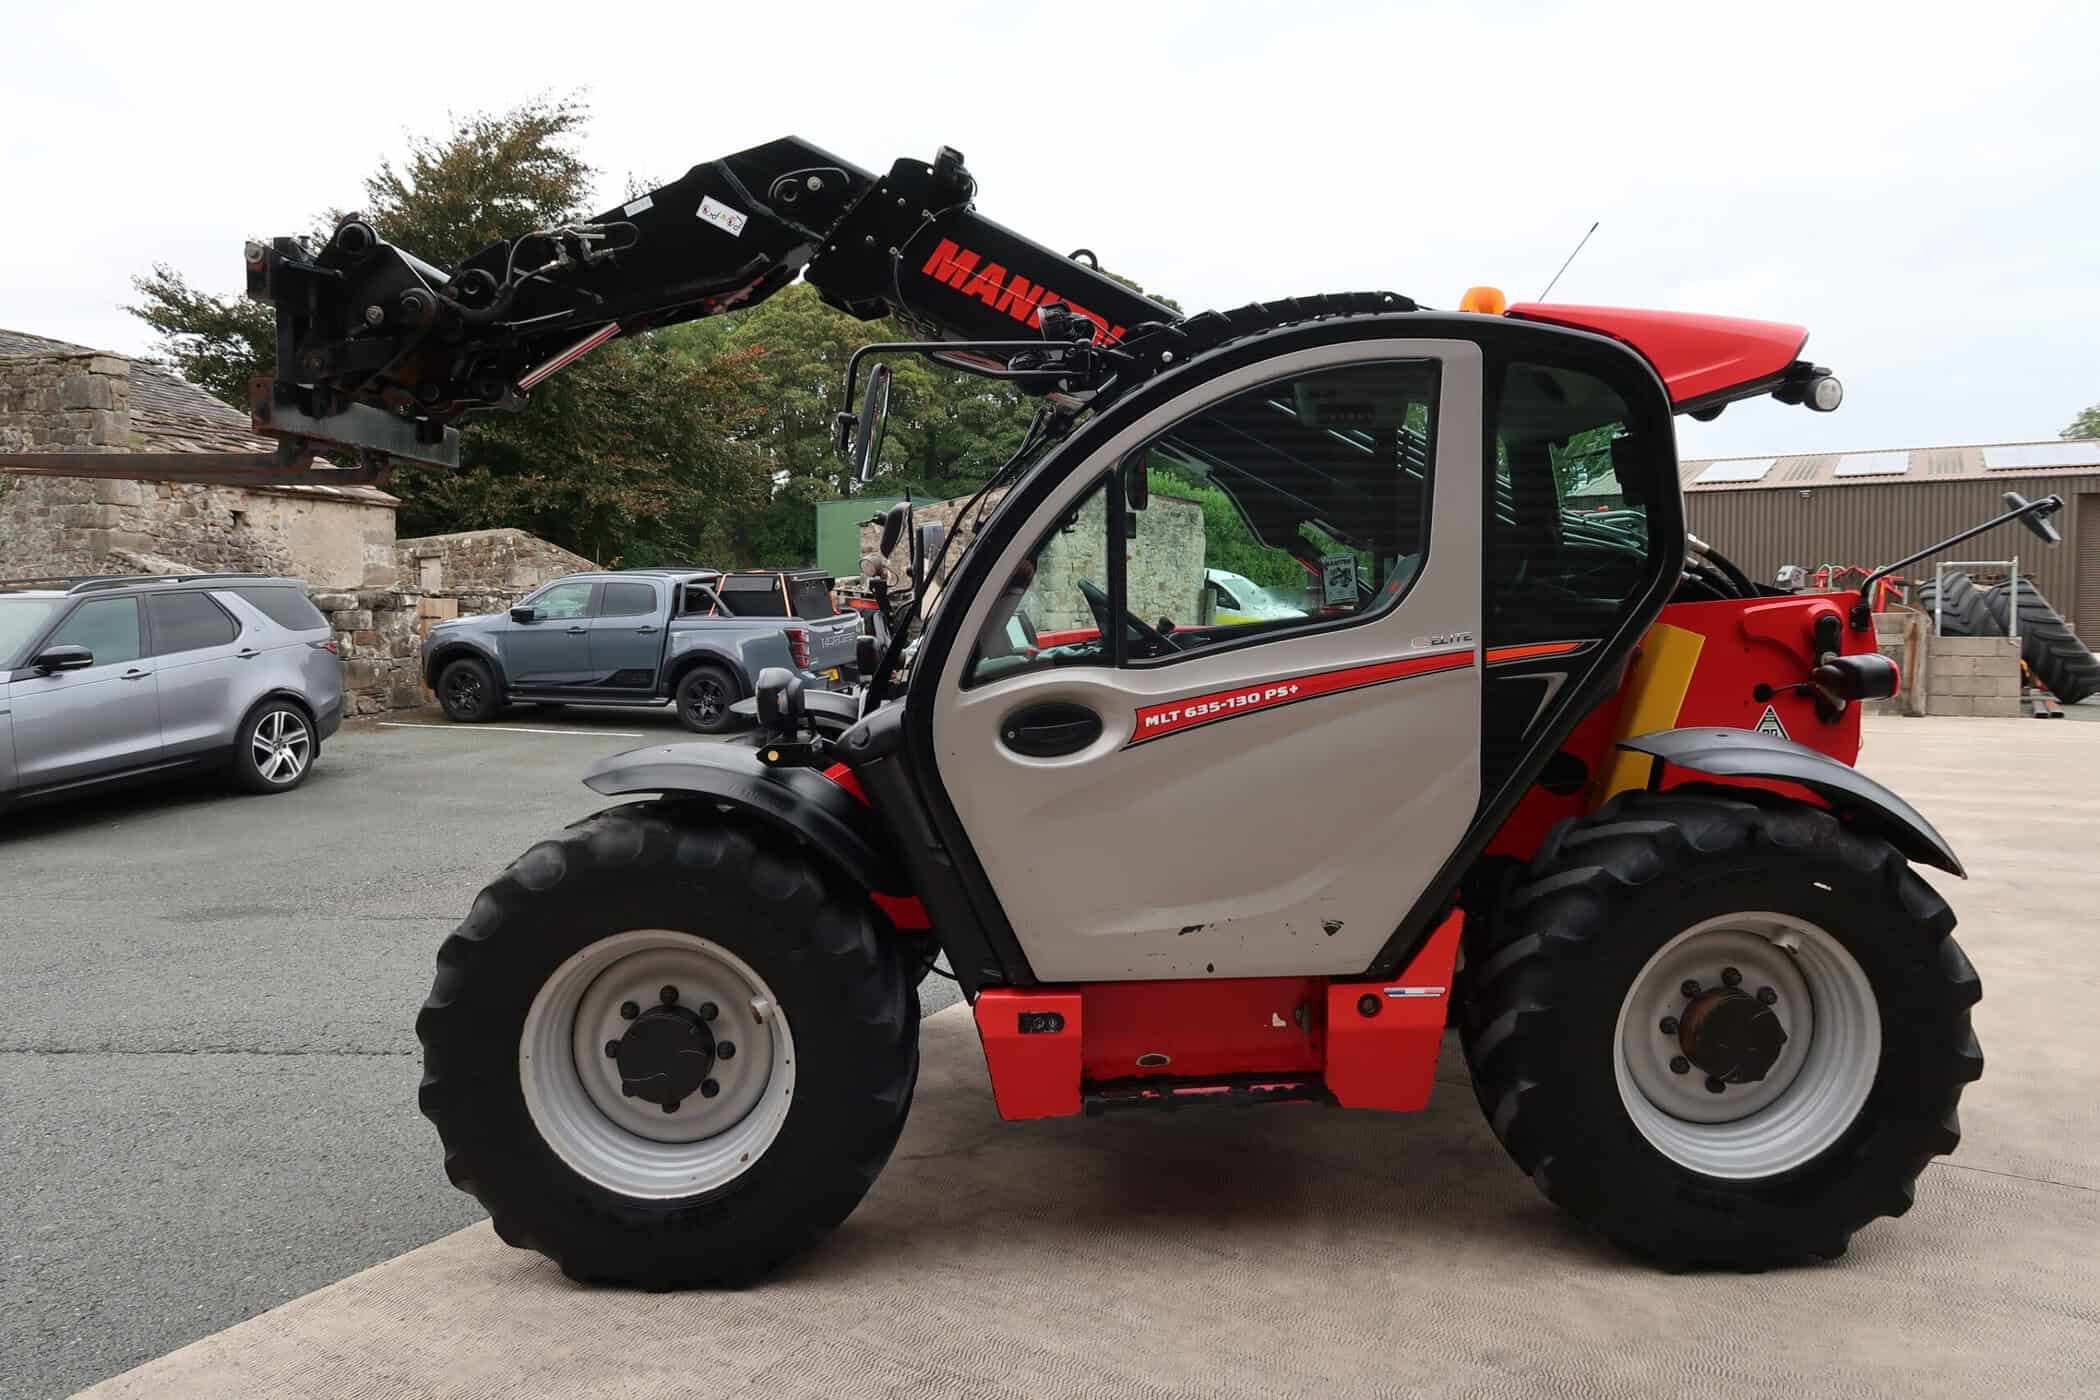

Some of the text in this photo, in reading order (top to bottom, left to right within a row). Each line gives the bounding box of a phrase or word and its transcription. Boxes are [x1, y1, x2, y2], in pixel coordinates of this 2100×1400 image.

[921, 238, 1127, 346] MANI
[1145, 684, 1299, 728] MLT 635-130 PS+
